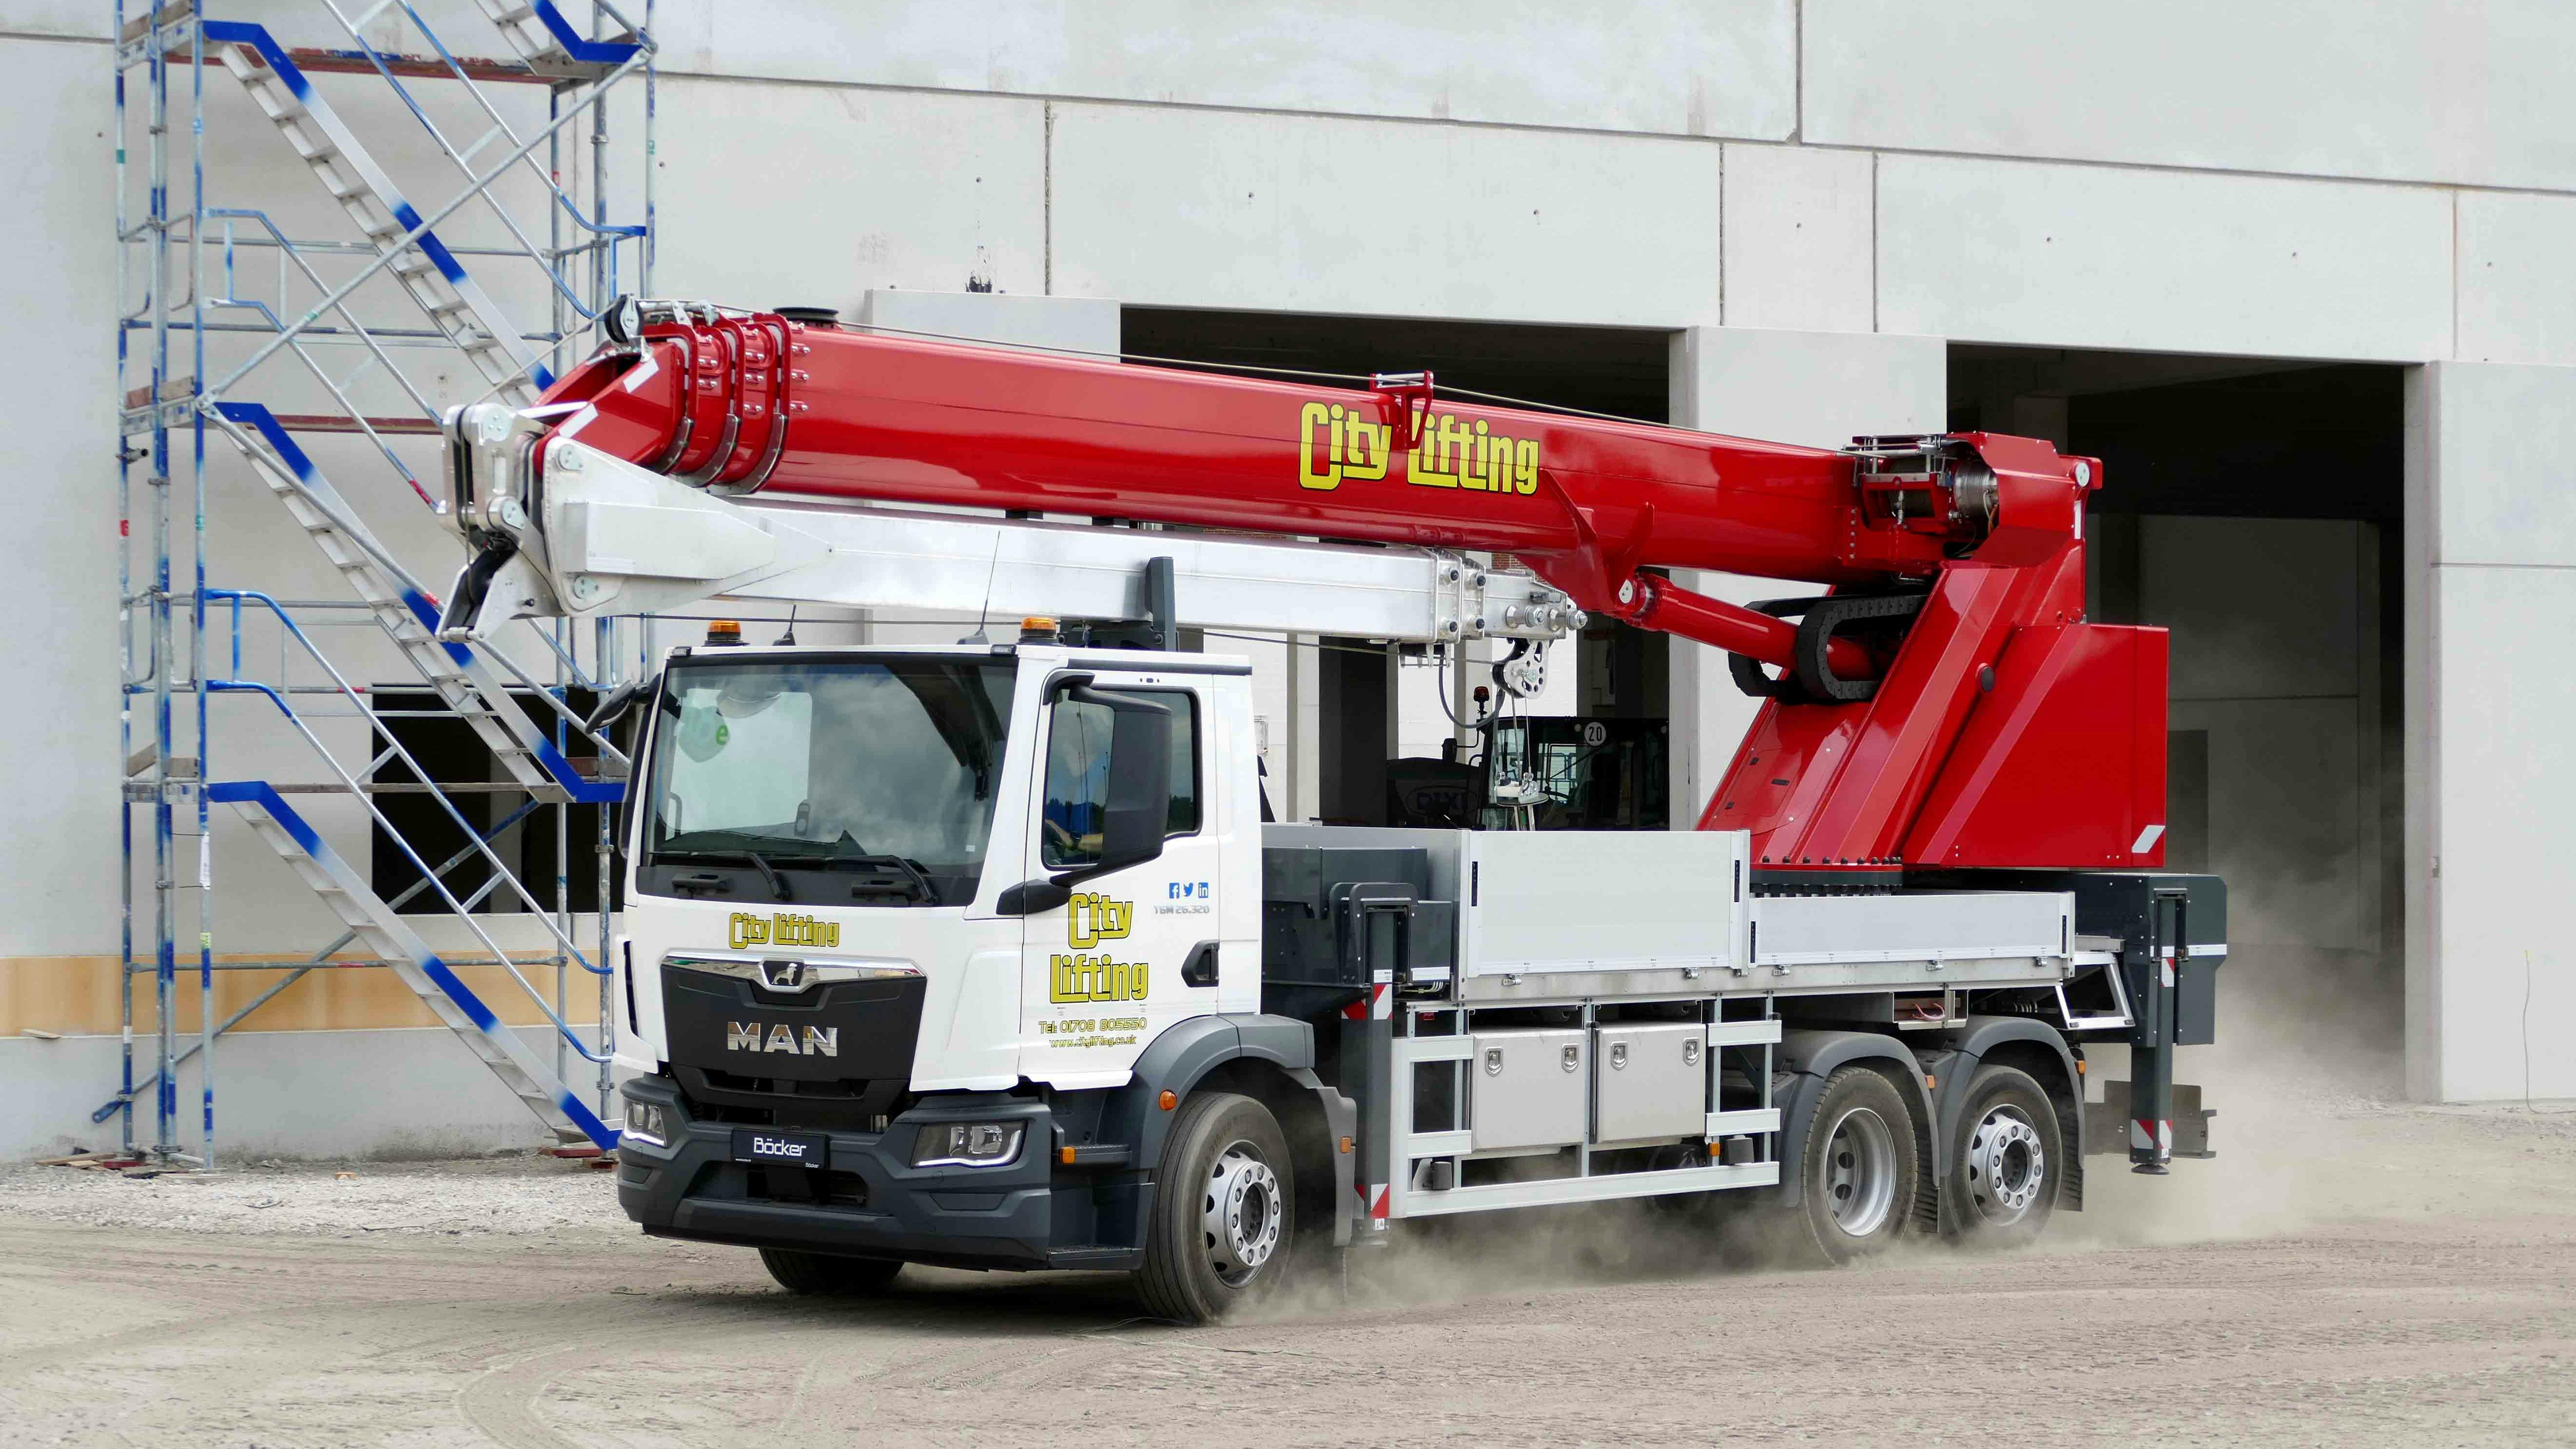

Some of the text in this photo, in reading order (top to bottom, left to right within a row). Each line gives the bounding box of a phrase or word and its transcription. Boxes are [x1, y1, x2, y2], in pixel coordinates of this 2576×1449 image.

[1298, 401, 1393, 490] City
[1589, 726, 1602, 741] 20
[728, 912, 771, 949] City
[1068, 892, 1133, 949] City
[1060, 1020, 1095, 1033] 01708
[1100, 1017, 1147, 1031] 805550
[727, 1021, 838, 1057] MAN
[1049, 1035, 1137, 1048] www.citylifting.co.uk
[754, 1137, 807, 1156] Böcker
